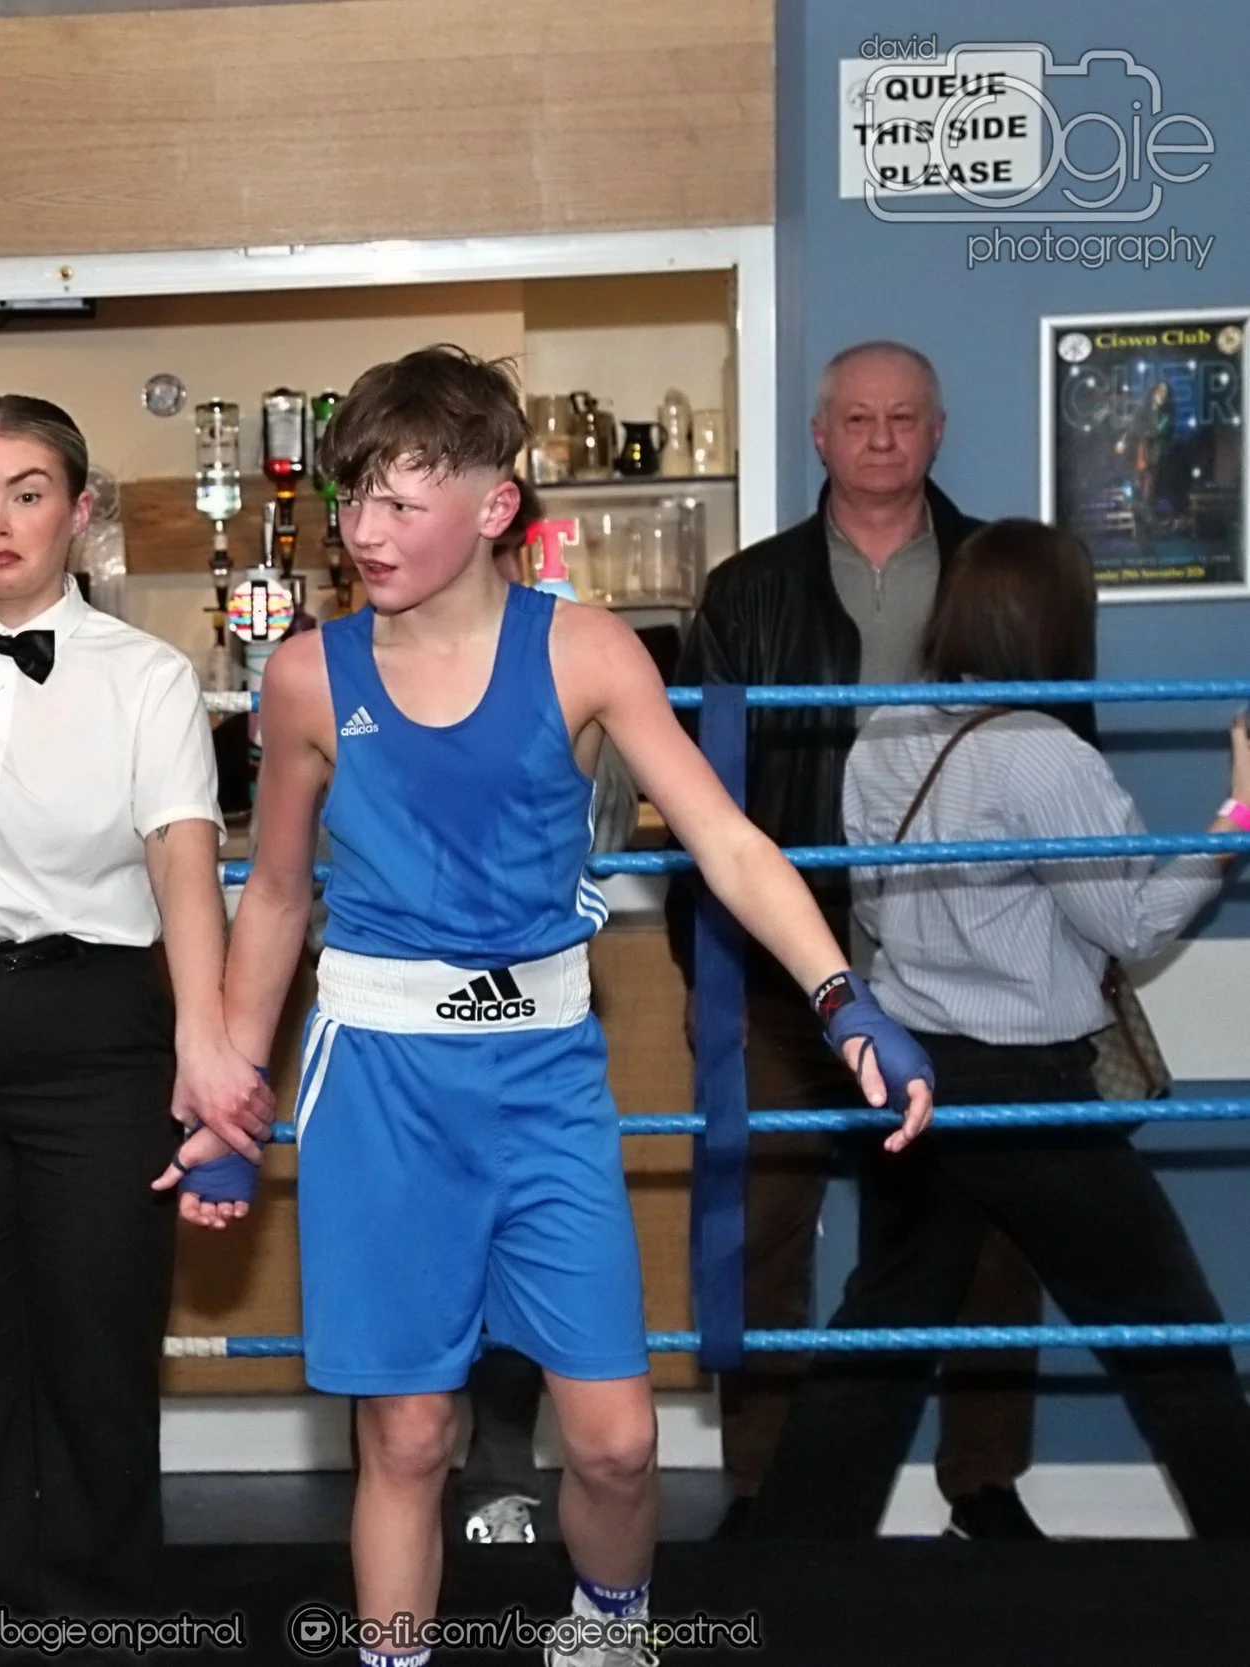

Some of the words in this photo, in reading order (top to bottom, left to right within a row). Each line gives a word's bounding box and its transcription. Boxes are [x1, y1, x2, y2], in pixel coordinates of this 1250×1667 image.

[885, 72, 1007, 101] QUEUE
[853, 121, 934, 147] THIS
[949, 115, 1028, 142] SIDE
[879, 160, 1013, 188] PLEASE
[1094, 332, 1157, 348] Ciswo
[1161, 329, 1212, 346] Club
[341, 722, 379, 737] adidas
[436, 998, 536, 1022] adidas
